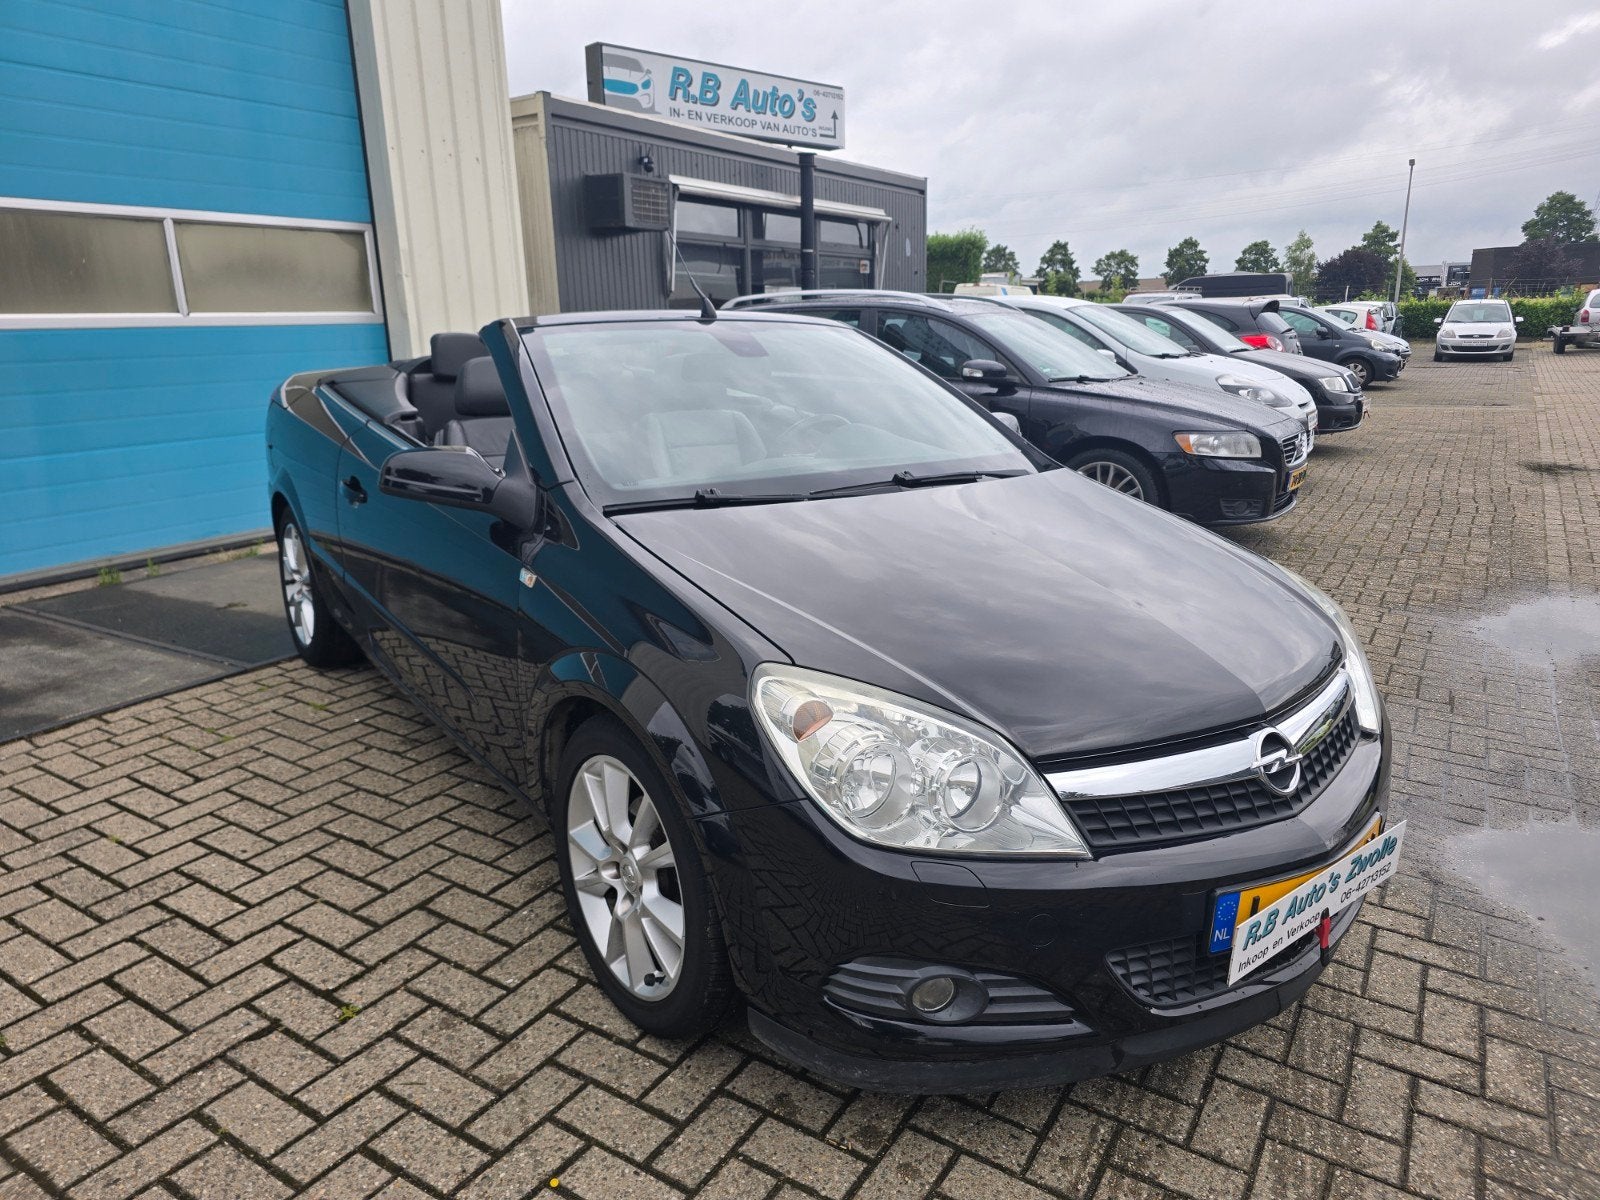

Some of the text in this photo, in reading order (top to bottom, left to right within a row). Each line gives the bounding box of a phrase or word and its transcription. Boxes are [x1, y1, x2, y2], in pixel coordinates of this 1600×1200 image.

[669, 66, 817, 122] R.B Auto's
[669, 106, 817, 138] IN- EN VERKOOP VAN AUTO'S
[1242, 835, 1398, 951] R.B Auto's Zwolle
[1214, 927, 1230, 942] NL
[1238, 911, 1320, 973] Inkoop en Verkoop
